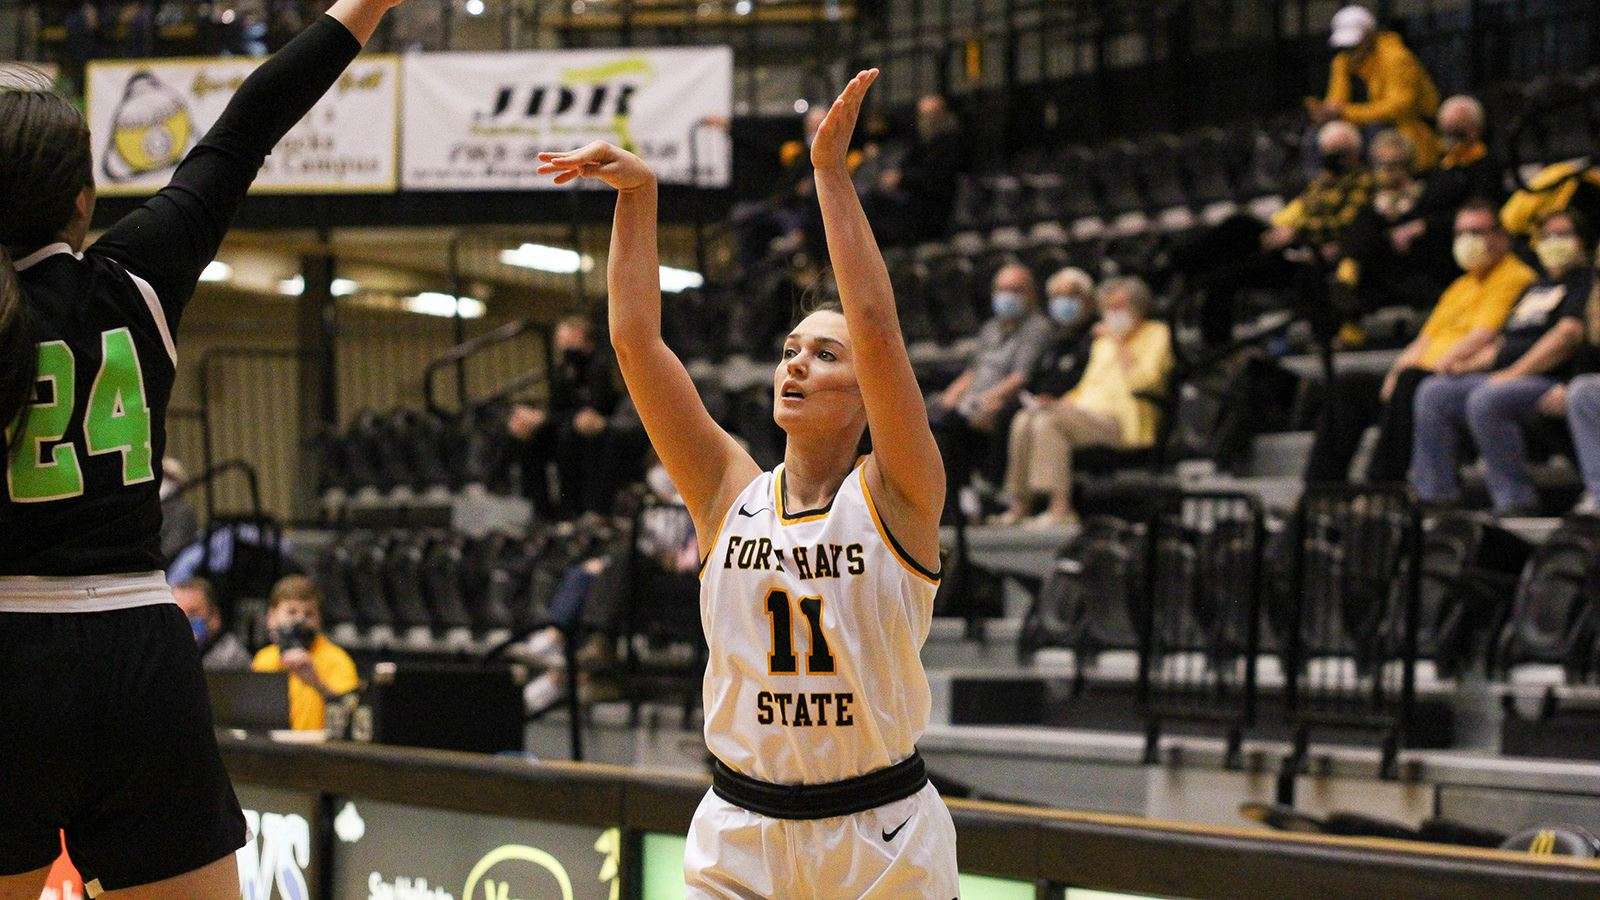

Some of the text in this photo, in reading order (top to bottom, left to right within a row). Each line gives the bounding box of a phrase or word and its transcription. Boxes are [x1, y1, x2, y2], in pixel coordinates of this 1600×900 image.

[6, 326, 154, 503] 24
[792, 543, 865, 580] HAYS
[764, 587, 838, 676] 11
[757, 691, 854, 727] STATE
